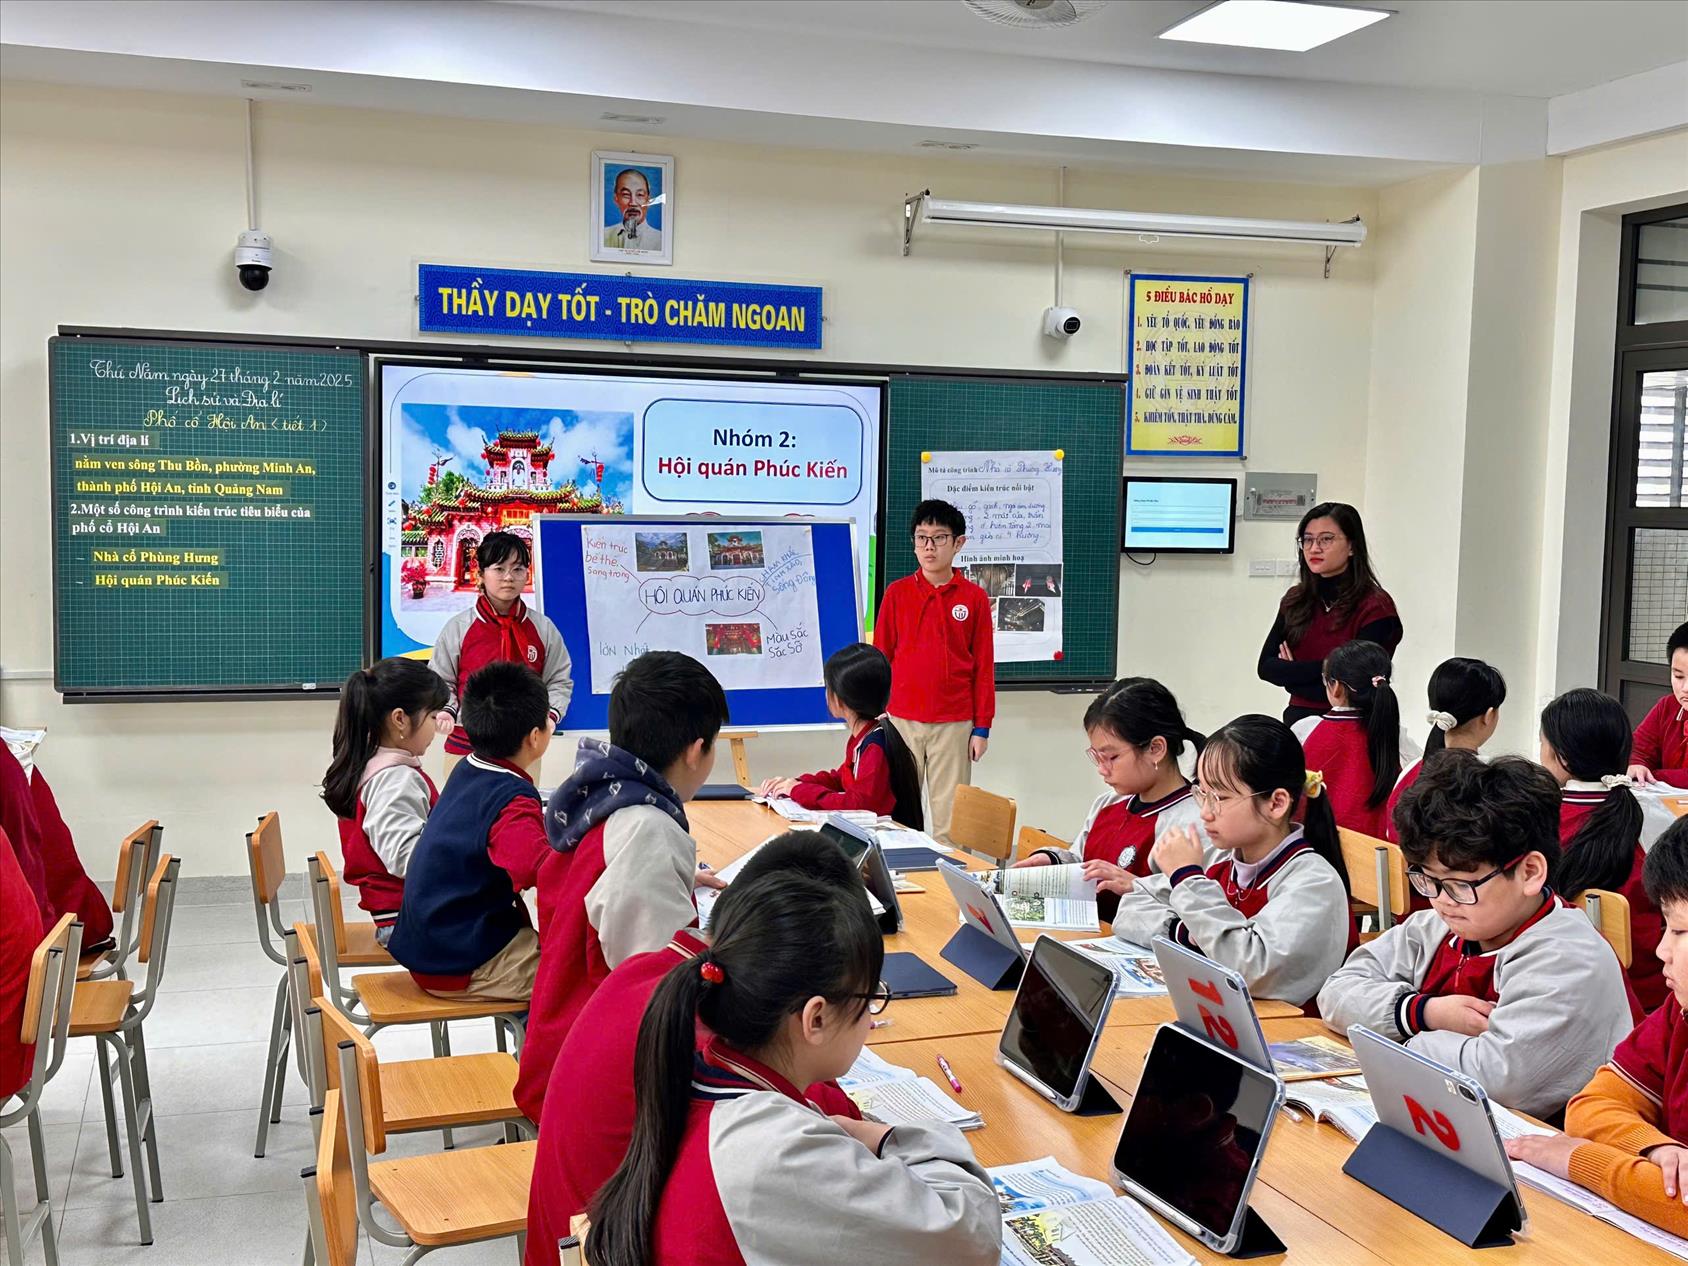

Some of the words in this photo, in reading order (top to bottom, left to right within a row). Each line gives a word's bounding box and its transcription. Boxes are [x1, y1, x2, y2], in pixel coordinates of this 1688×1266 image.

[438, 277, 499, 316] THẦY
[505, 291, 552, 327] DẠY
[557, 282, 600, 322] TỐT
[617, 291, 659, 325] TRÒ
[665, 294, 726, 328] CHĂM
[732, 303, 805, 332] NGOAN
[1146, 291, 1152, 302] 5
[1154, 285, 1177, 302] ĐIỀU
[1179, 288, 1198, 303] BÁC
[1200, 287, 1213, 303] HỒ
[1215, 293, 1235, 307] DẠY
[1193, 342, 1205, 353] LAO
[1228, 337, 1240, 353] TỐT
[89, 359, 125, 379] Thứ
[129, 362, 169, 380] Năm
[172, 370, 208, 390] ngày
[210, 368, 225, 382] 27
[230, 367, 269, 392] tháng
[273, 371, 281, 384] 2
[285, 375, 319, 386] năm
[319, 373, 353, 387] 2025
[1228, 361, 1239, 377] TỐT
[166, 386, 199, 406] Lịch
[223, 394, 240, 406] và
[241, 390, 268, 410] Địa
[271, 390, 284, 408] lí
[1187, 389, 1201, 400] SINH
[1227, 384, 1238, 401] TỐT
[143, 409, 178, 427] Phố
[207, 413, 237, 432] Hội
[241, 414, 266, 430] An
[98, 434, 114, 445] trí
[118, 435, 137, 448] địa
[140, 435, 149, 446] lí
[713, 428, 773, 448] Nhóm
[779, 430, 796, 448] 2:
[75, 455, 101, 469] nằm
[105, 460, 125, 469] ven
[129, 459, 156, 473] sông
[158, 460, 182, 471] Thu
[186, 457, 212, 473] Bồn,
[215, 461, 260, 475] phường
[262, 462, 293, 473] Minh
[295, 463, 316, 475] An,
[658, 456, 692, 478] Hội
[698, 458, 747, 479] quán
[754, 459, 801, 478] Phúc
[807, 459, 848, 479] Kiến
[77, 481, 112, 492] thành
[115, 478, 137, 495] phố
[141, 482, 161, 495] Hội
[164, 483, 185, 495] An,
[188, 483, 211, 494] tỉnh
[214, 483, 254, 497] Quảng
[256, 484, 283, 495] Nam
[108, 501, 121, 515] số
[124, 504, 151, 517] công
[154, 505, 183, 516] trình
[186, 502, 211, 516] kiến
[213, 505, 238, 516] trúc
[240, 506, 261, 517] tiêu
[264, 504, 288, 517] biểu
[291, 506, 311, 517] của
[72, 520, 96, 535] phố
[99, 520, 114, 533] cổ
[117, 522, 139, 535] Hội
[142, 523, 161, 533] An
[93, 551, 119, 562] Nhà
[123, 549, 137, 562] cổ
[140, 551, 180, 565] Phùng
[184, 552, 219, 566] Hưng
[961, 555, 978, 563] Hình
[994, 554, 1011, 562] minh
[95, 574, 117, 587] Hội
[121, 574, 153, 588] quán
[156, 574, 187, 586] Phúc
[190, 572, 220, 586] Kiến
[674, 586, 706, 605] QUÁN
[710, 584, 735, 601] PHÚC
[738, 582, 760, 600] KIẾN
[1188, 977, 1238, 1050] 12
[1402, 1094, 1460, 1152] 2
